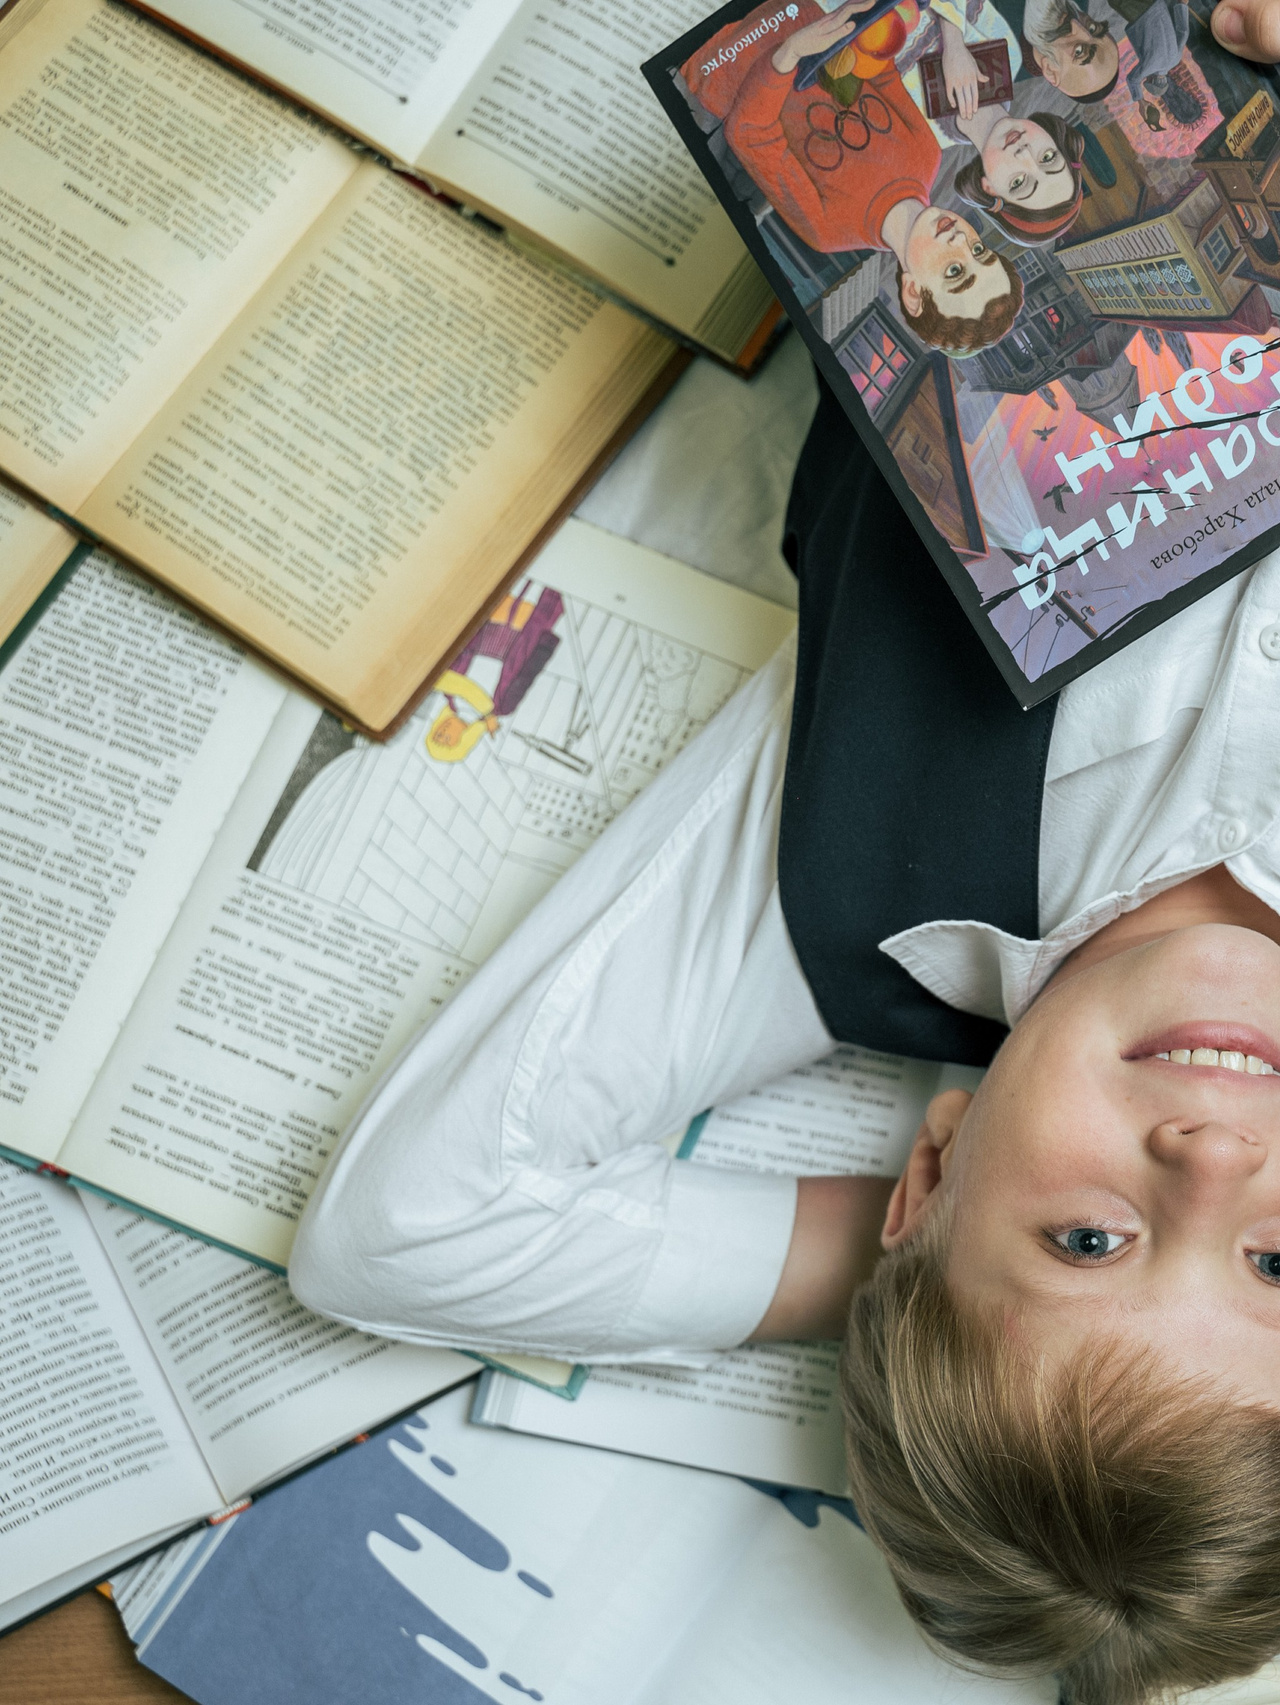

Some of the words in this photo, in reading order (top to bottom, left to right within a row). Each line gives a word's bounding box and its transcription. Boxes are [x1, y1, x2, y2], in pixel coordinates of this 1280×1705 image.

[701, 11, 786, 76] абрикобукс
[1247, 111, 1257, 128] НА
[1255, 96, 1270, 119] ВИНО
[1229, 121, 1250, 151] ВИНОС
[1054, 336, 1264, 494] один
[1150, 509, 1247, 570] Харебова
